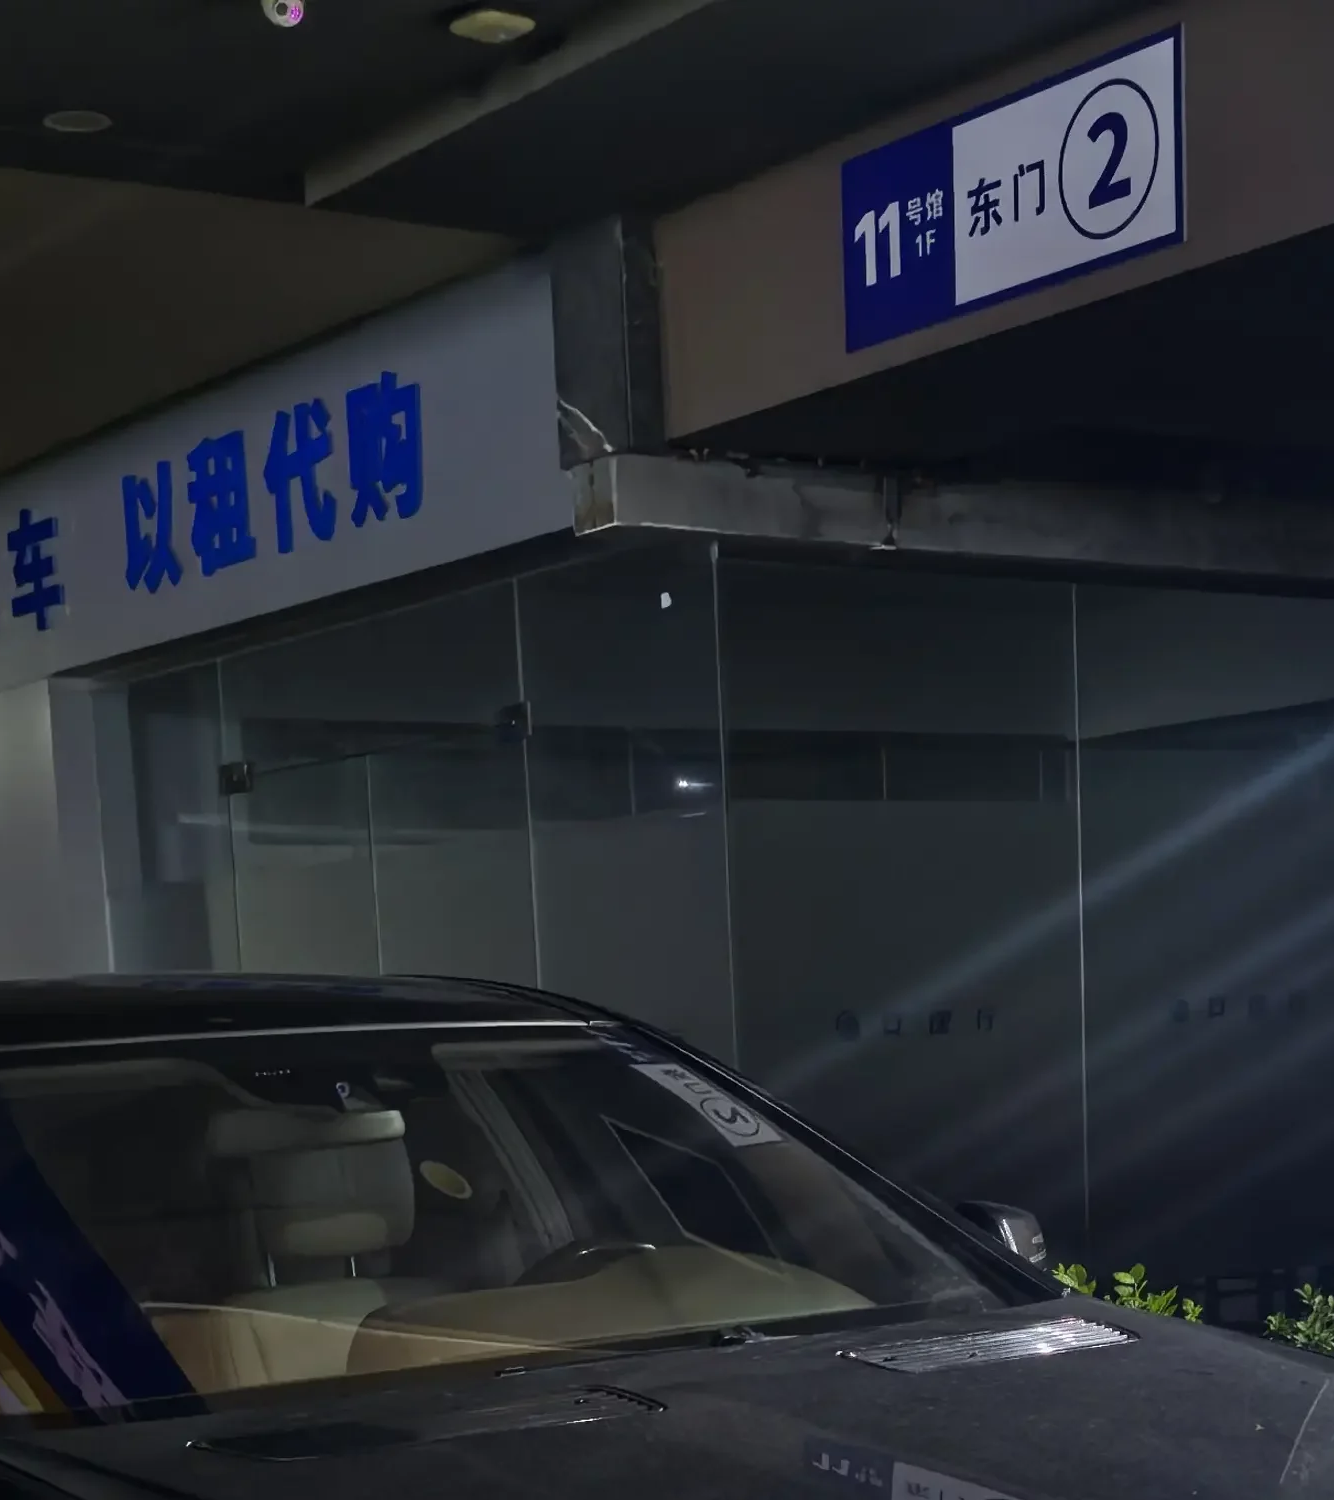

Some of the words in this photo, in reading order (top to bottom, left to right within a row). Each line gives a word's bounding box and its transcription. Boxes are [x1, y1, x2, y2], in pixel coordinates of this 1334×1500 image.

[854, 201, 902, 288] 11
[906, 188, 944, 226] 号馆
[967, 159, 1046, 238] 东门
[915, 229, 937, 258] 1F
[121, 370, 424, 594] 以租代购
